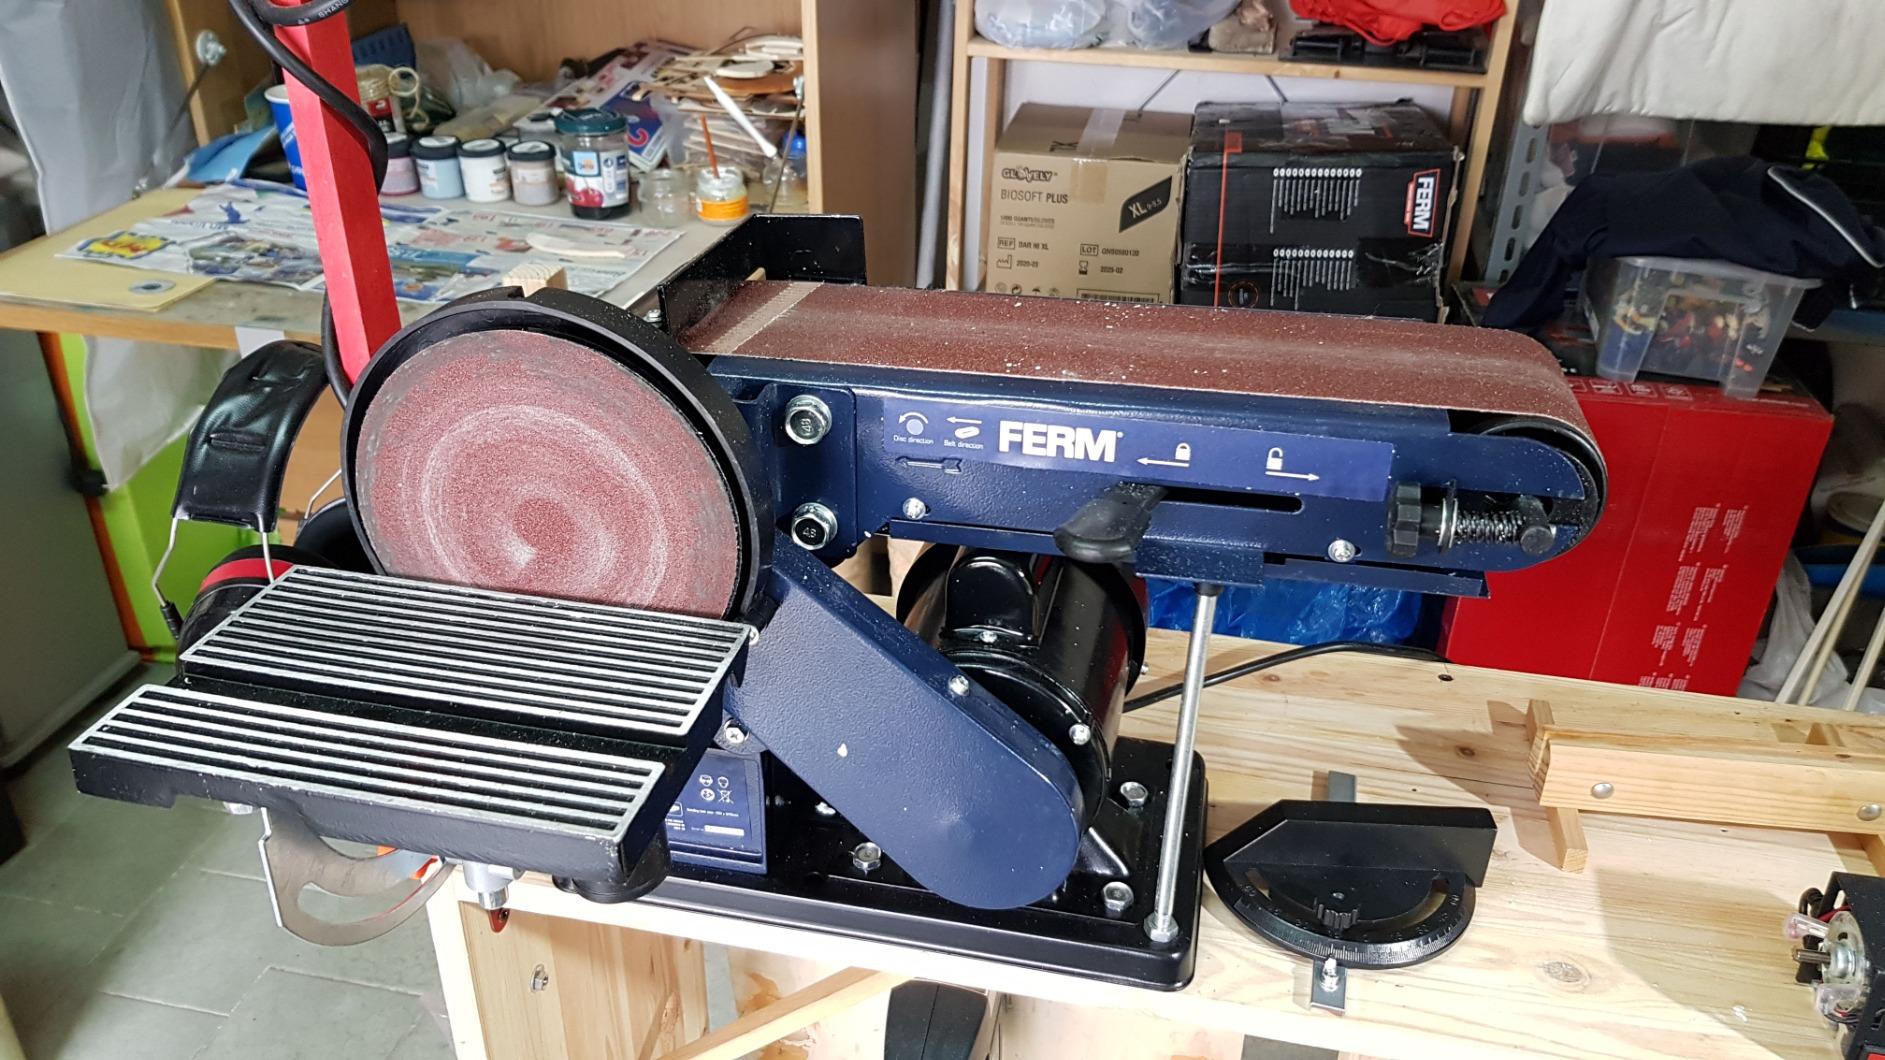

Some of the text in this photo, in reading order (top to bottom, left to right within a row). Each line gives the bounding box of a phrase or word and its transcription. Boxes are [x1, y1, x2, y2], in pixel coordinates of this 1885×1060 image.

[1000, 189, 1068, 204] BIOSOFT PLUS
[1413, 177, 1435, 230] FERM
[1128, 202, 1147, 218] XL
[1082, 246, 1097, 254] LOT
[893, 434, 934, 444] Disc direction
[944, 439, 984, 450] Belt direction
[998, 420, 1117, 462] FERM
